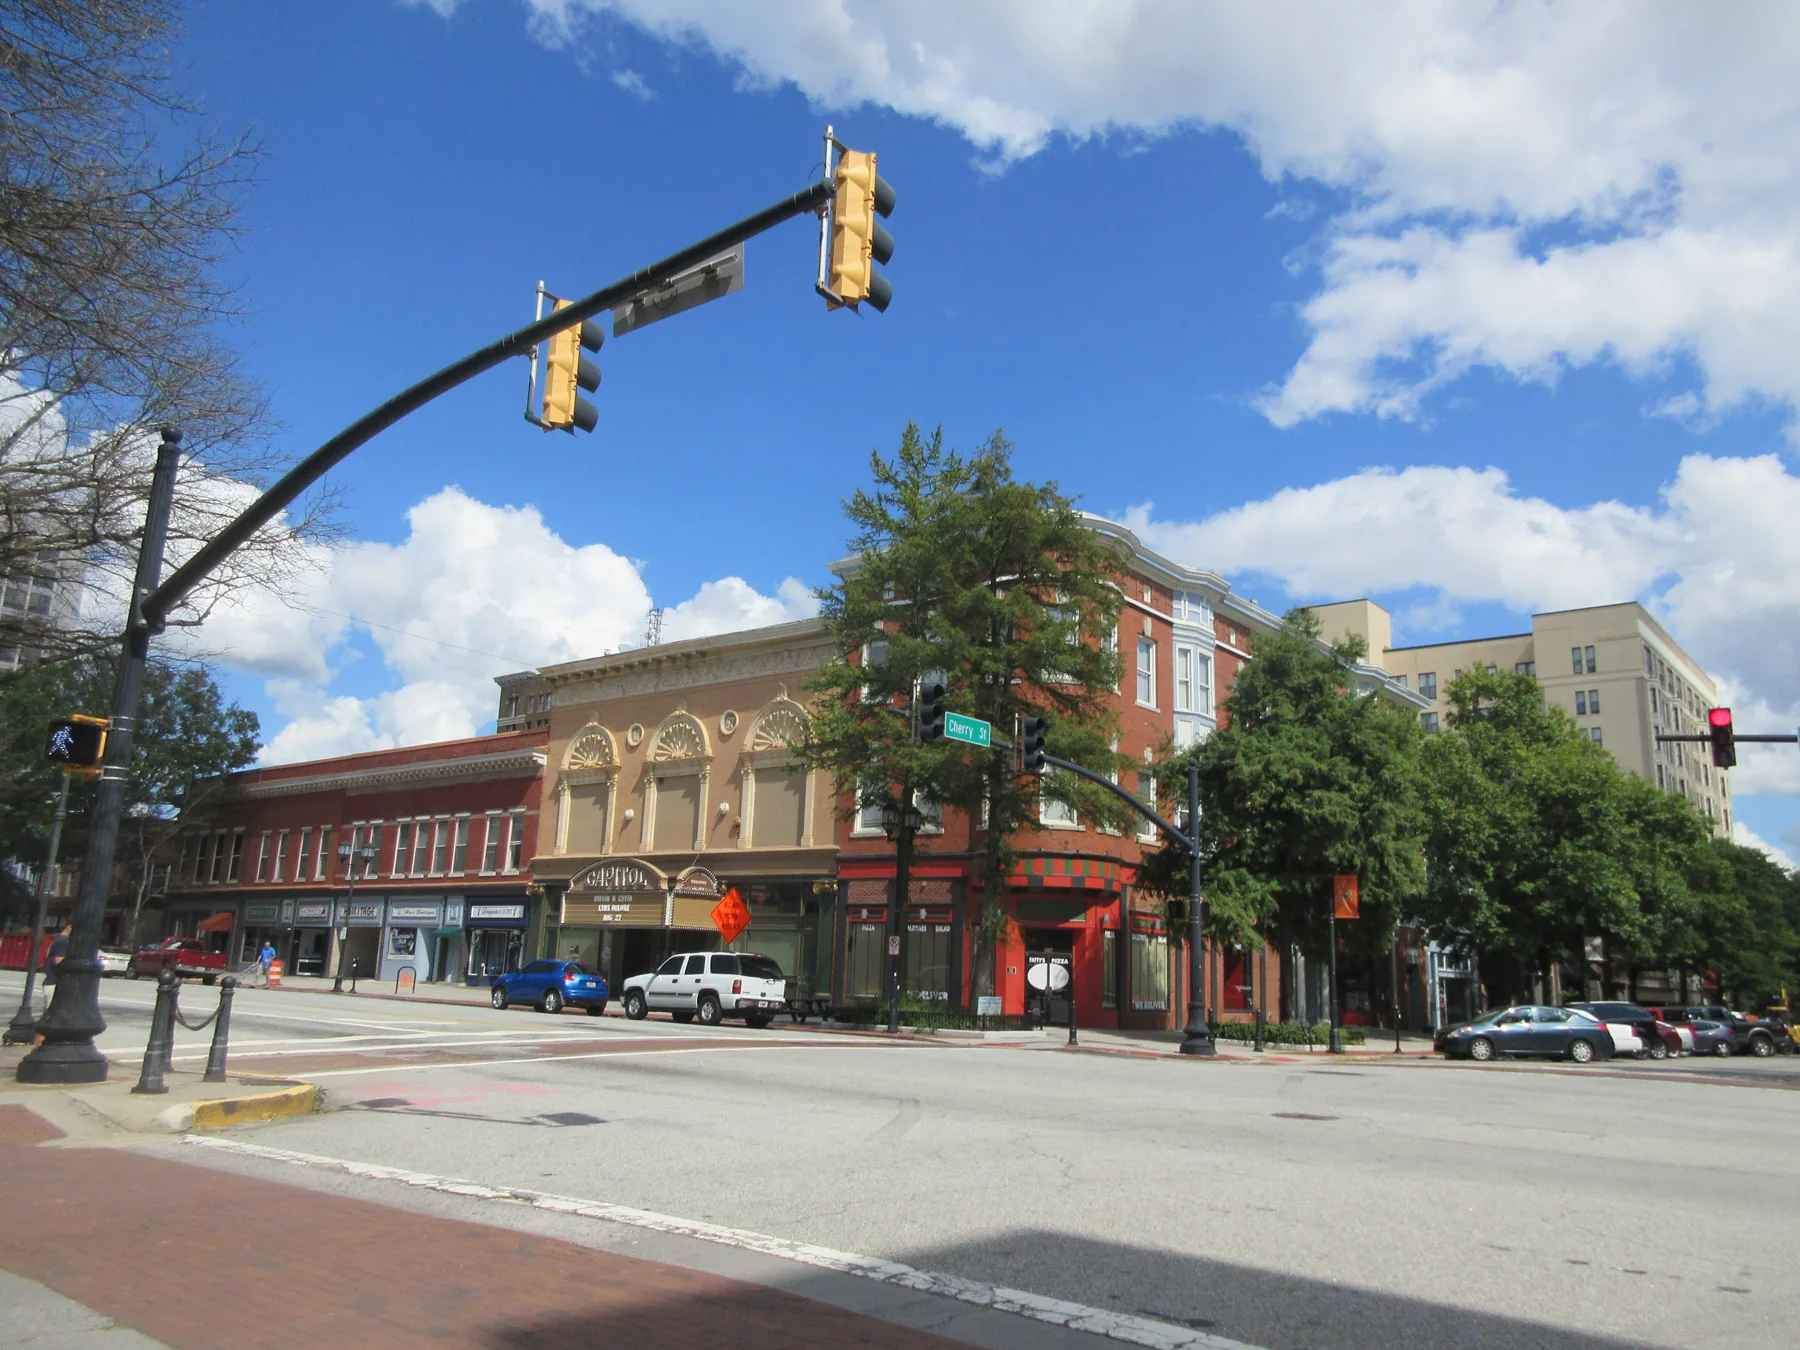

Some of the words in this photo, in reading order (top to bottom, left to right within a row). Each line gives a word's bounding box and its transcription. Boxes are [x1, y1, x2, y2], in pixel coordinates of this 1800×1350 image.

[948, 719, 974, 740] Cherry
[979, 727, 988, 740] St
[586, 866, 648, 887] CAPITOL
[724, 901, 740, 909] ROAD
[342, 906, 375, 917] HIRITAGE
[721, 921, 741, 930] AHEAD
[1051, 957, 1069, 965] PIZZA
